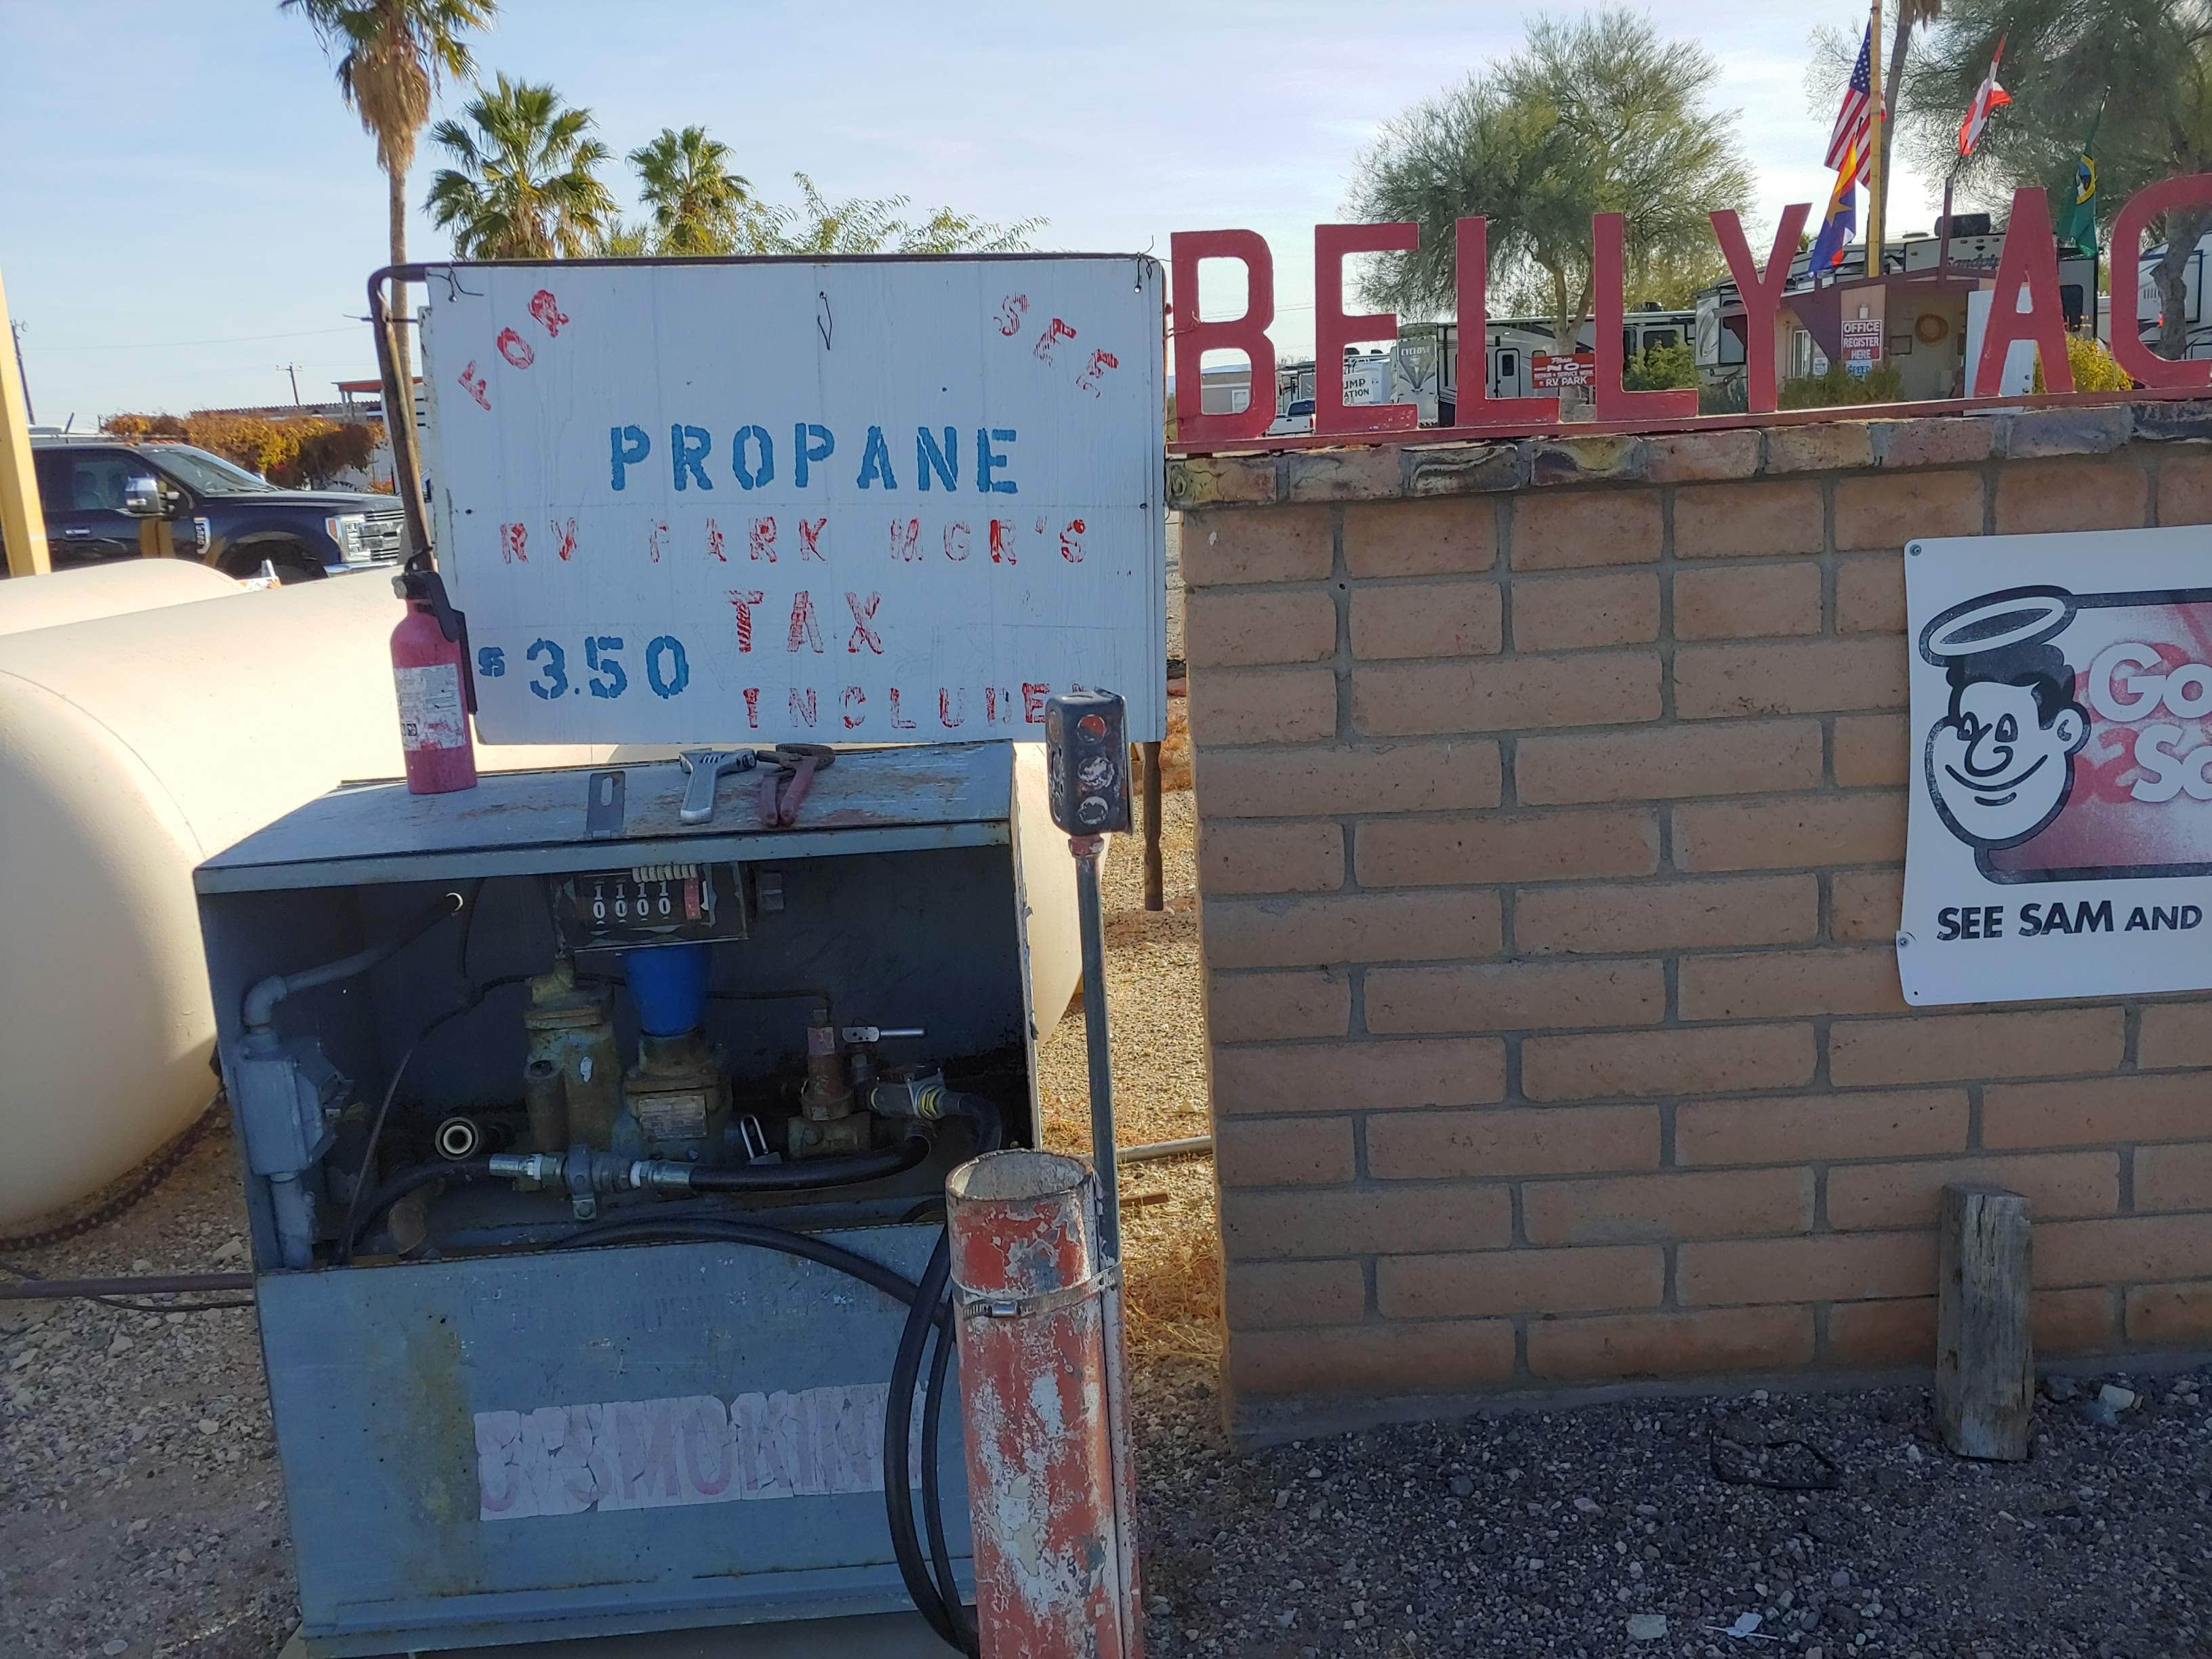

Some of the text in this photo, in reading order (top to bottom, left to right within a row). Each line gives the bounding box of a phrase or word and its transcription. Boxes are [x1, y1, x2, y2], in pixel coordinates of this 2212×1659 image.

[1170, 203, 1813, 441] BELLY
[1843, 337, 1879, 348] REGISTER
[1844, 322, 1880, 333] OFFICE
[457, 289, 570, 411] FOR
[1401, 346, 1431, 356] CYCLONE
[1851, 349, 1871, 360] HERE
[1546, 378, 1559, 386] RV
[1561, 376, 1587, 386] PARK
[610, 422, 1019, 494] PROPANE
[500, 517, 578, 564] RV
[649, 516, 827, 563] PARK
[726, 590, 884, 654] TAX
[743, 682, 1086, 729] INCLUDE
[1937, 900, 2203, 941] SEE SAM AND
